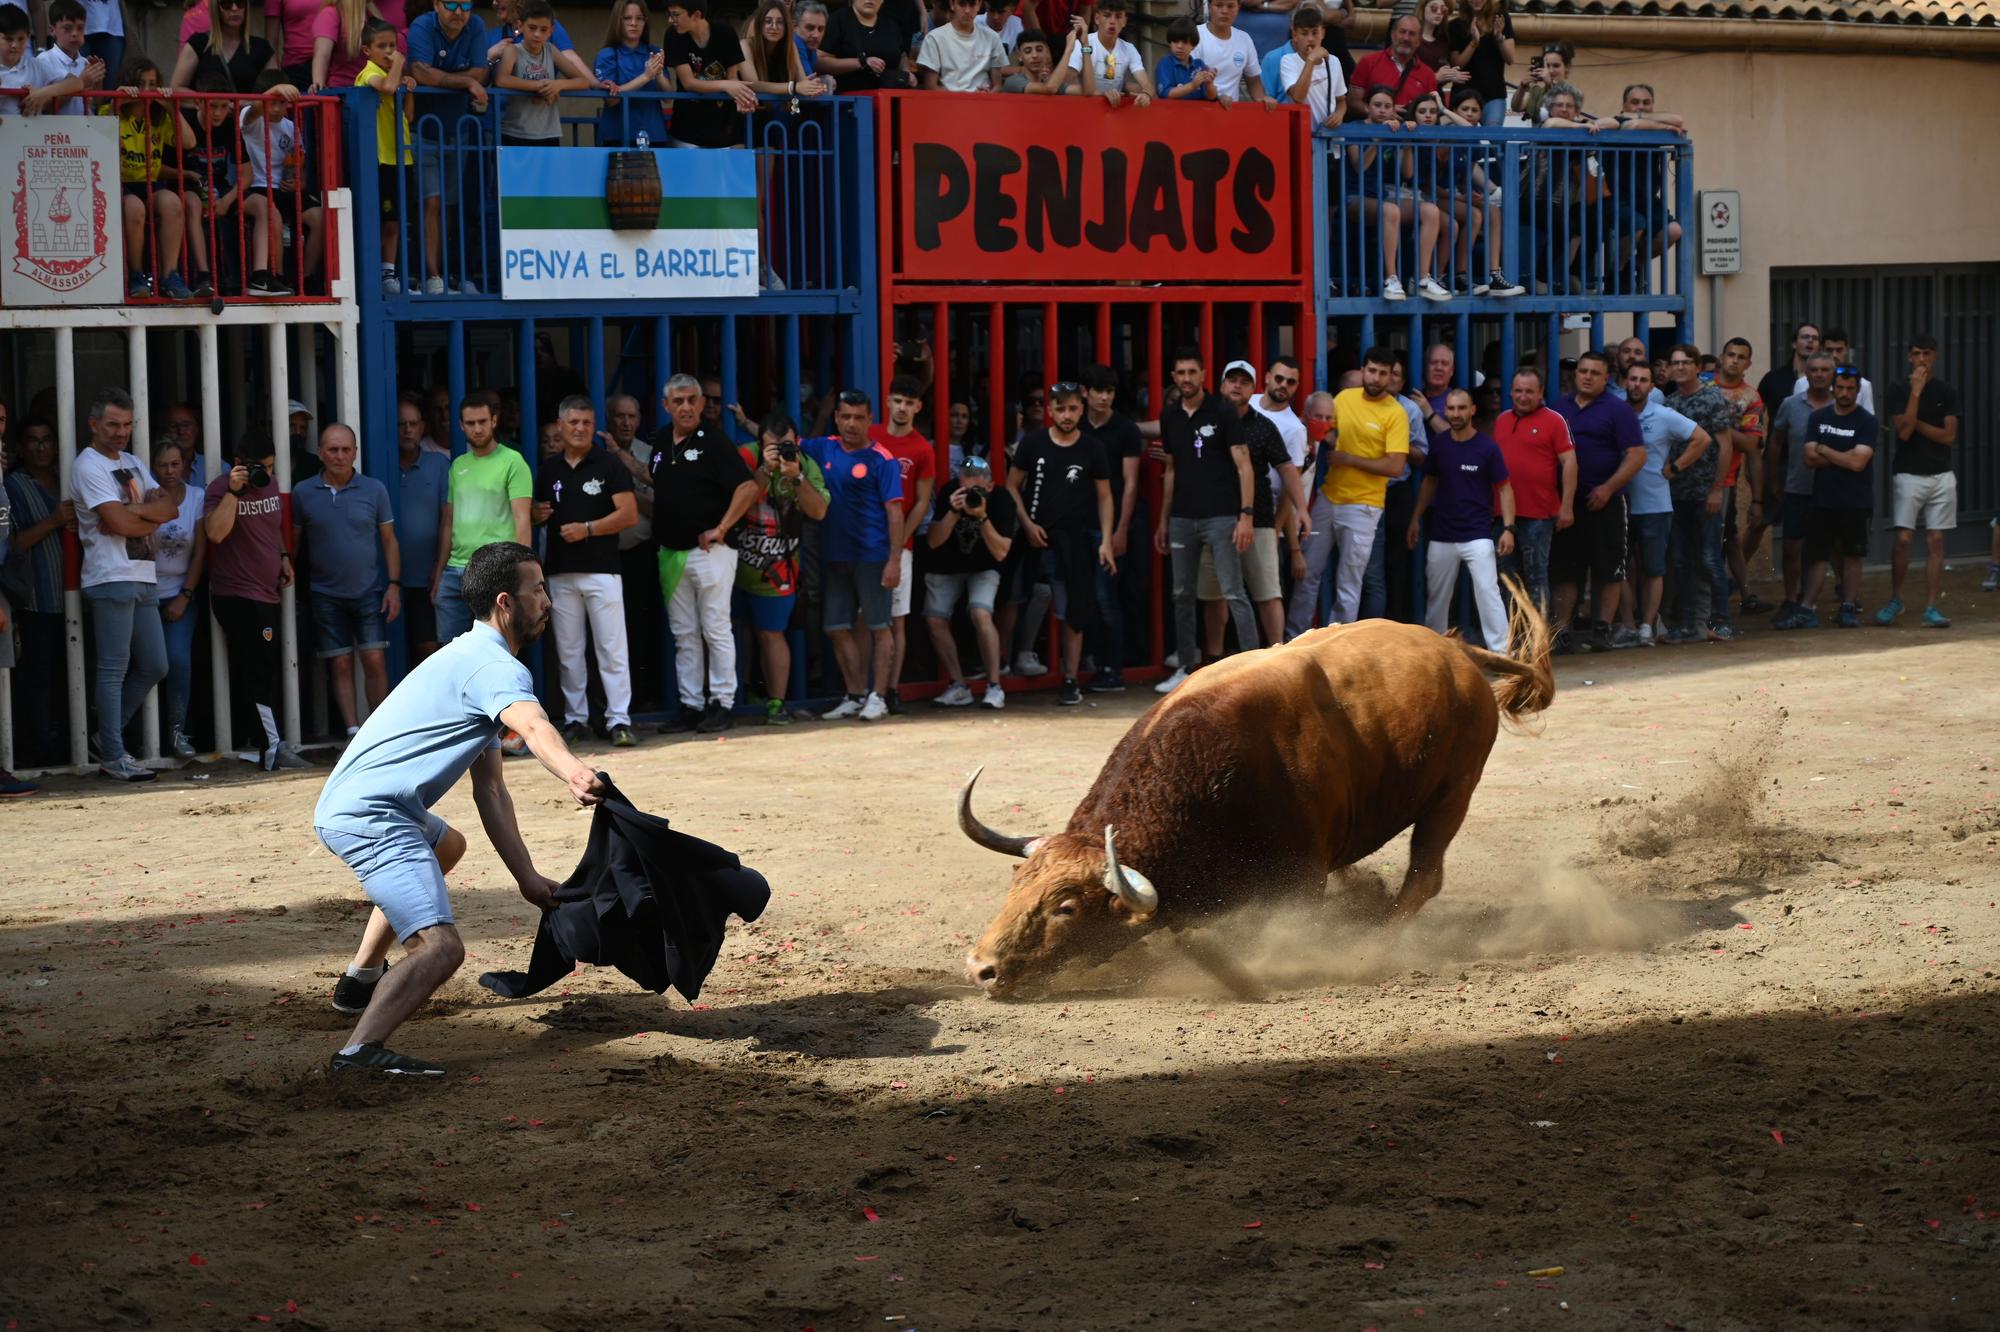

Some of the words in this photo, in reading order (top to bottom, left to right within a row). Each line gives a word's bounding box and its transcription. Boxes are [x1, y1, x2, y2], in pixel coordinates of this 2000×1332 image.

[44, 132, 71, 145] PEÑA
[27, 147, 48, 159] SAN
[51, 147, 89, 159] FERMIN
[903, 141, 1276, 254] PENJATS
[505, 249, 589, 280] PENYA
[600, 252, 625, 279] EL
[636, 247, 756, 278] BARRILET
[31, 268, 92, 287] ALMASSORA
